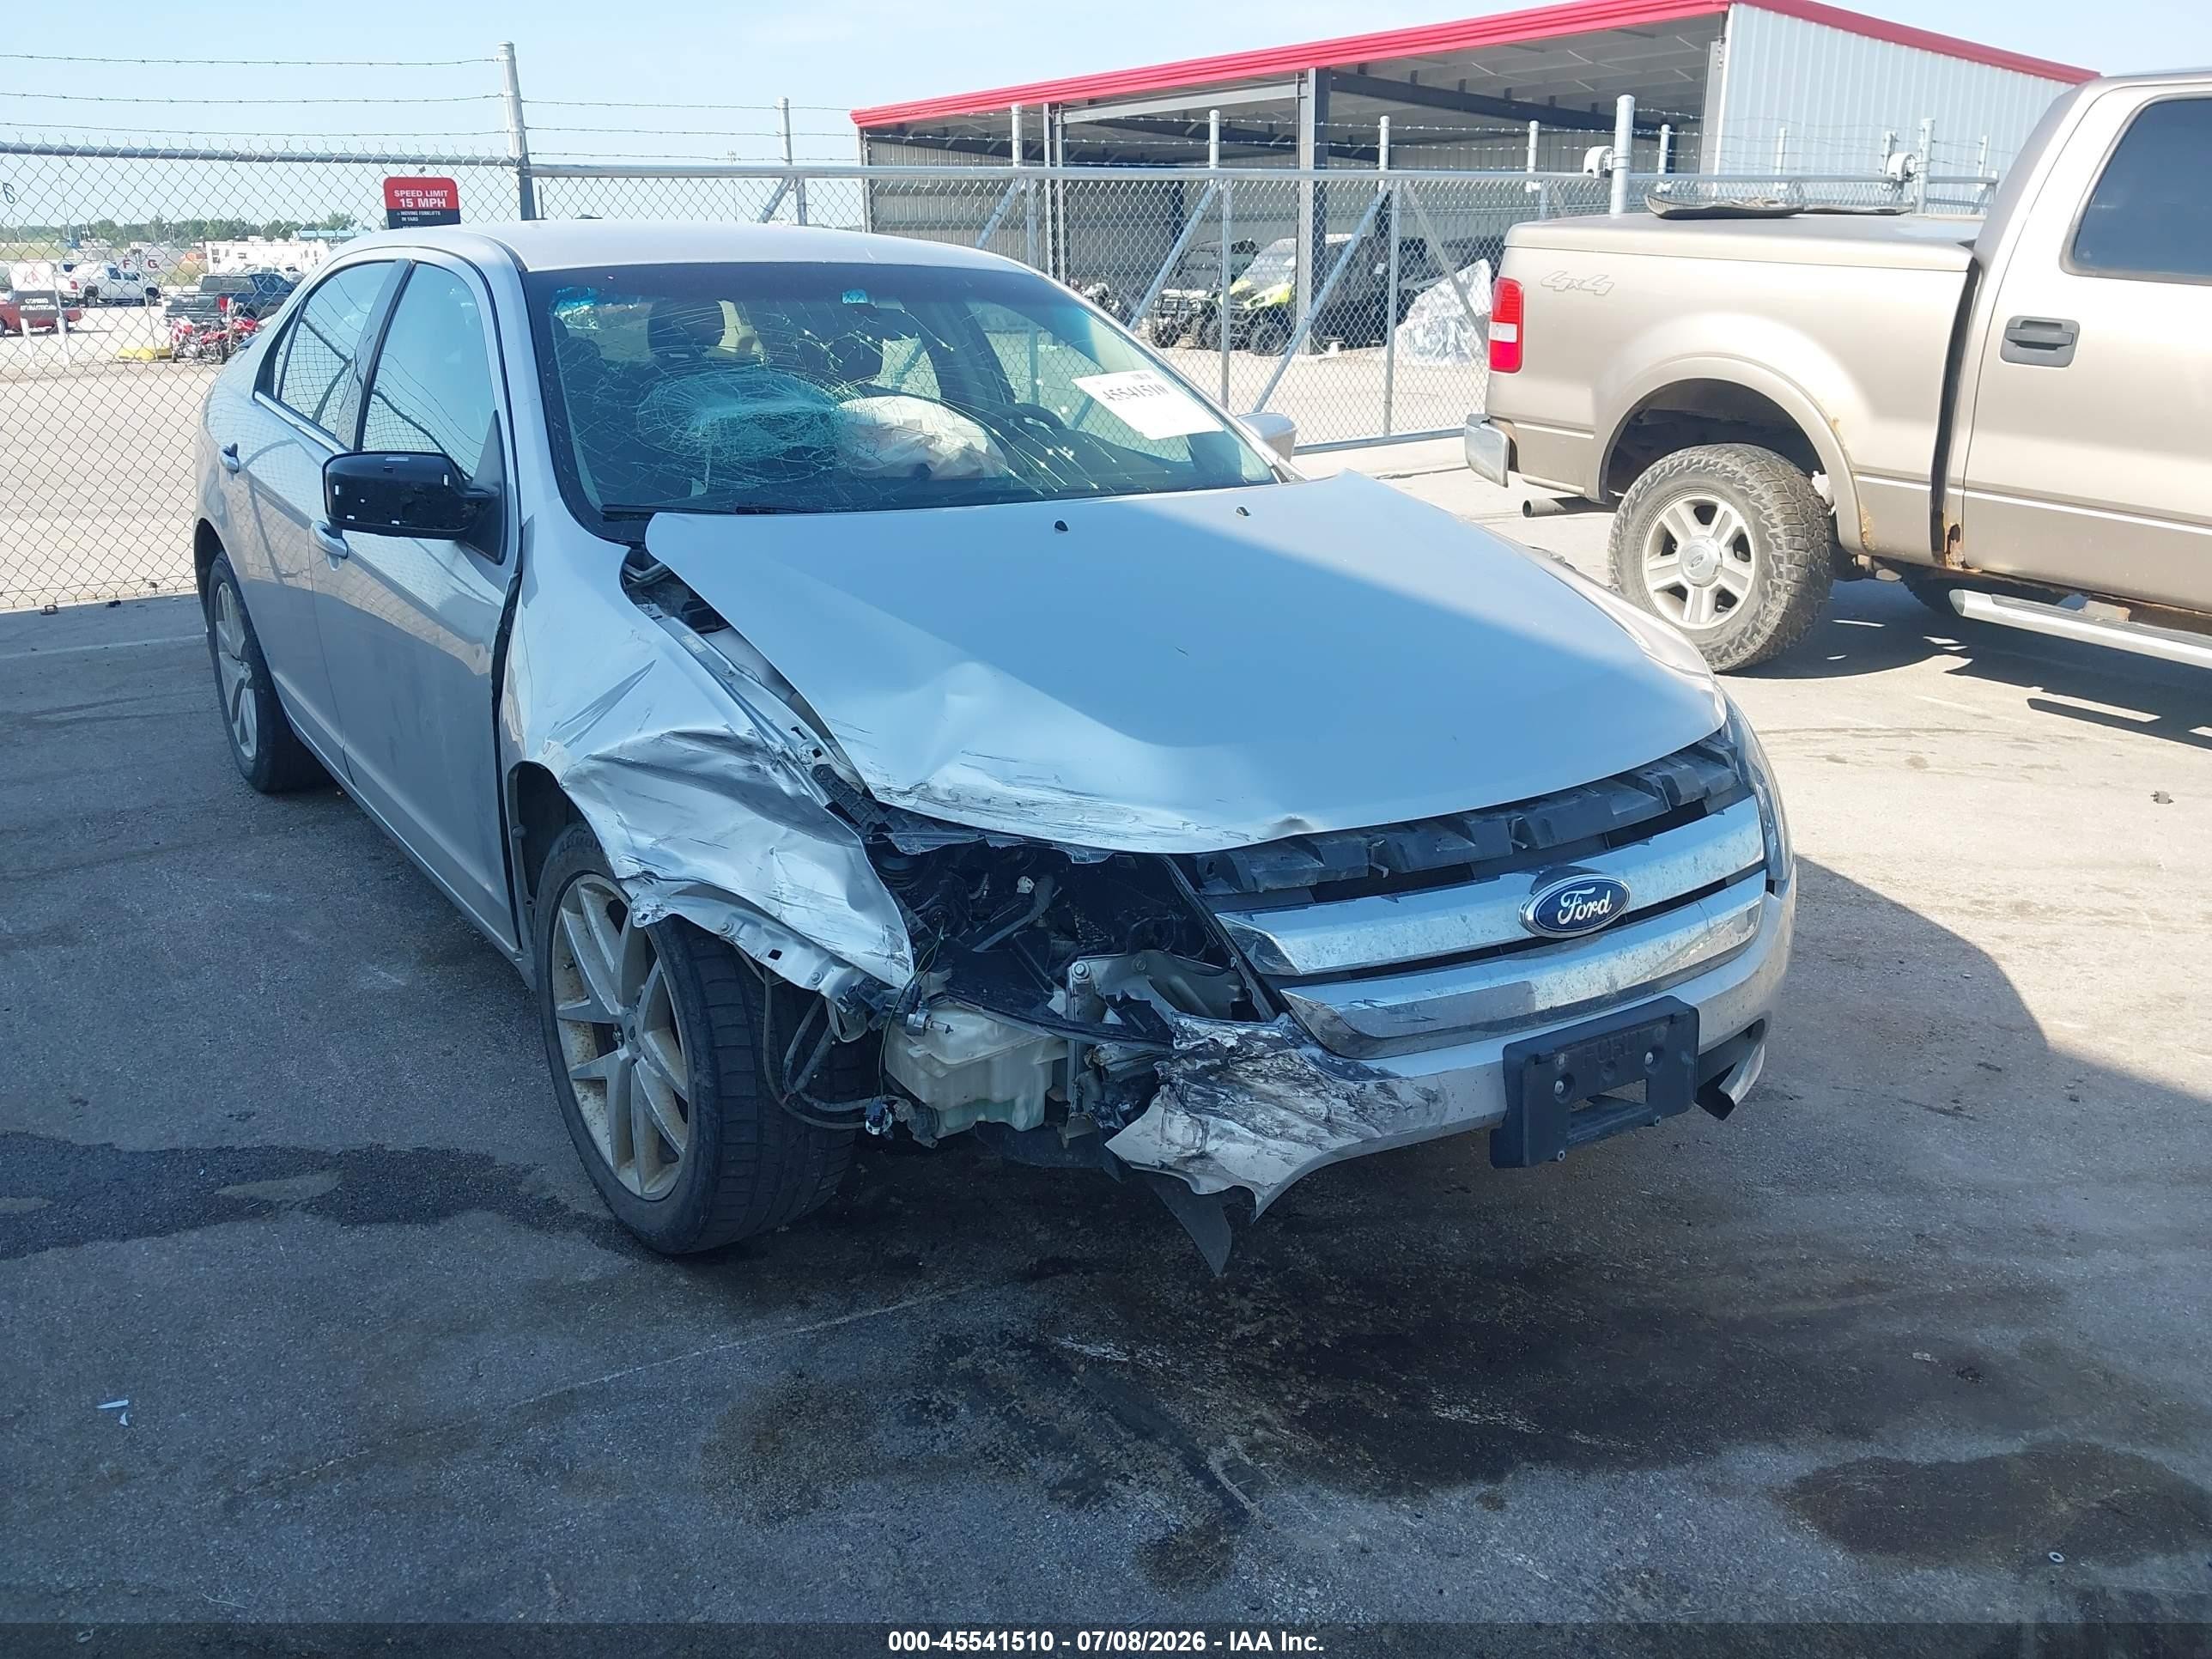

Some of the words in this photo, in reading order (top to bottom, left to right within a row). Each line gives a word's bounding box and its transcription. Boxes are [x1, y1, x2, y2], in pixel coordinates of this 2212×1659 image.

[393, 189, 422, 198] SPEED
[399, 198, 414, 208] 15
[417, 198, 447, 208] MPH
[123, 259, 131, 269] F
[148, 259, 158, 269] G
[1540, 270, 1615, 296] 4x4
[1558, 886, 1613, 925] Ford
